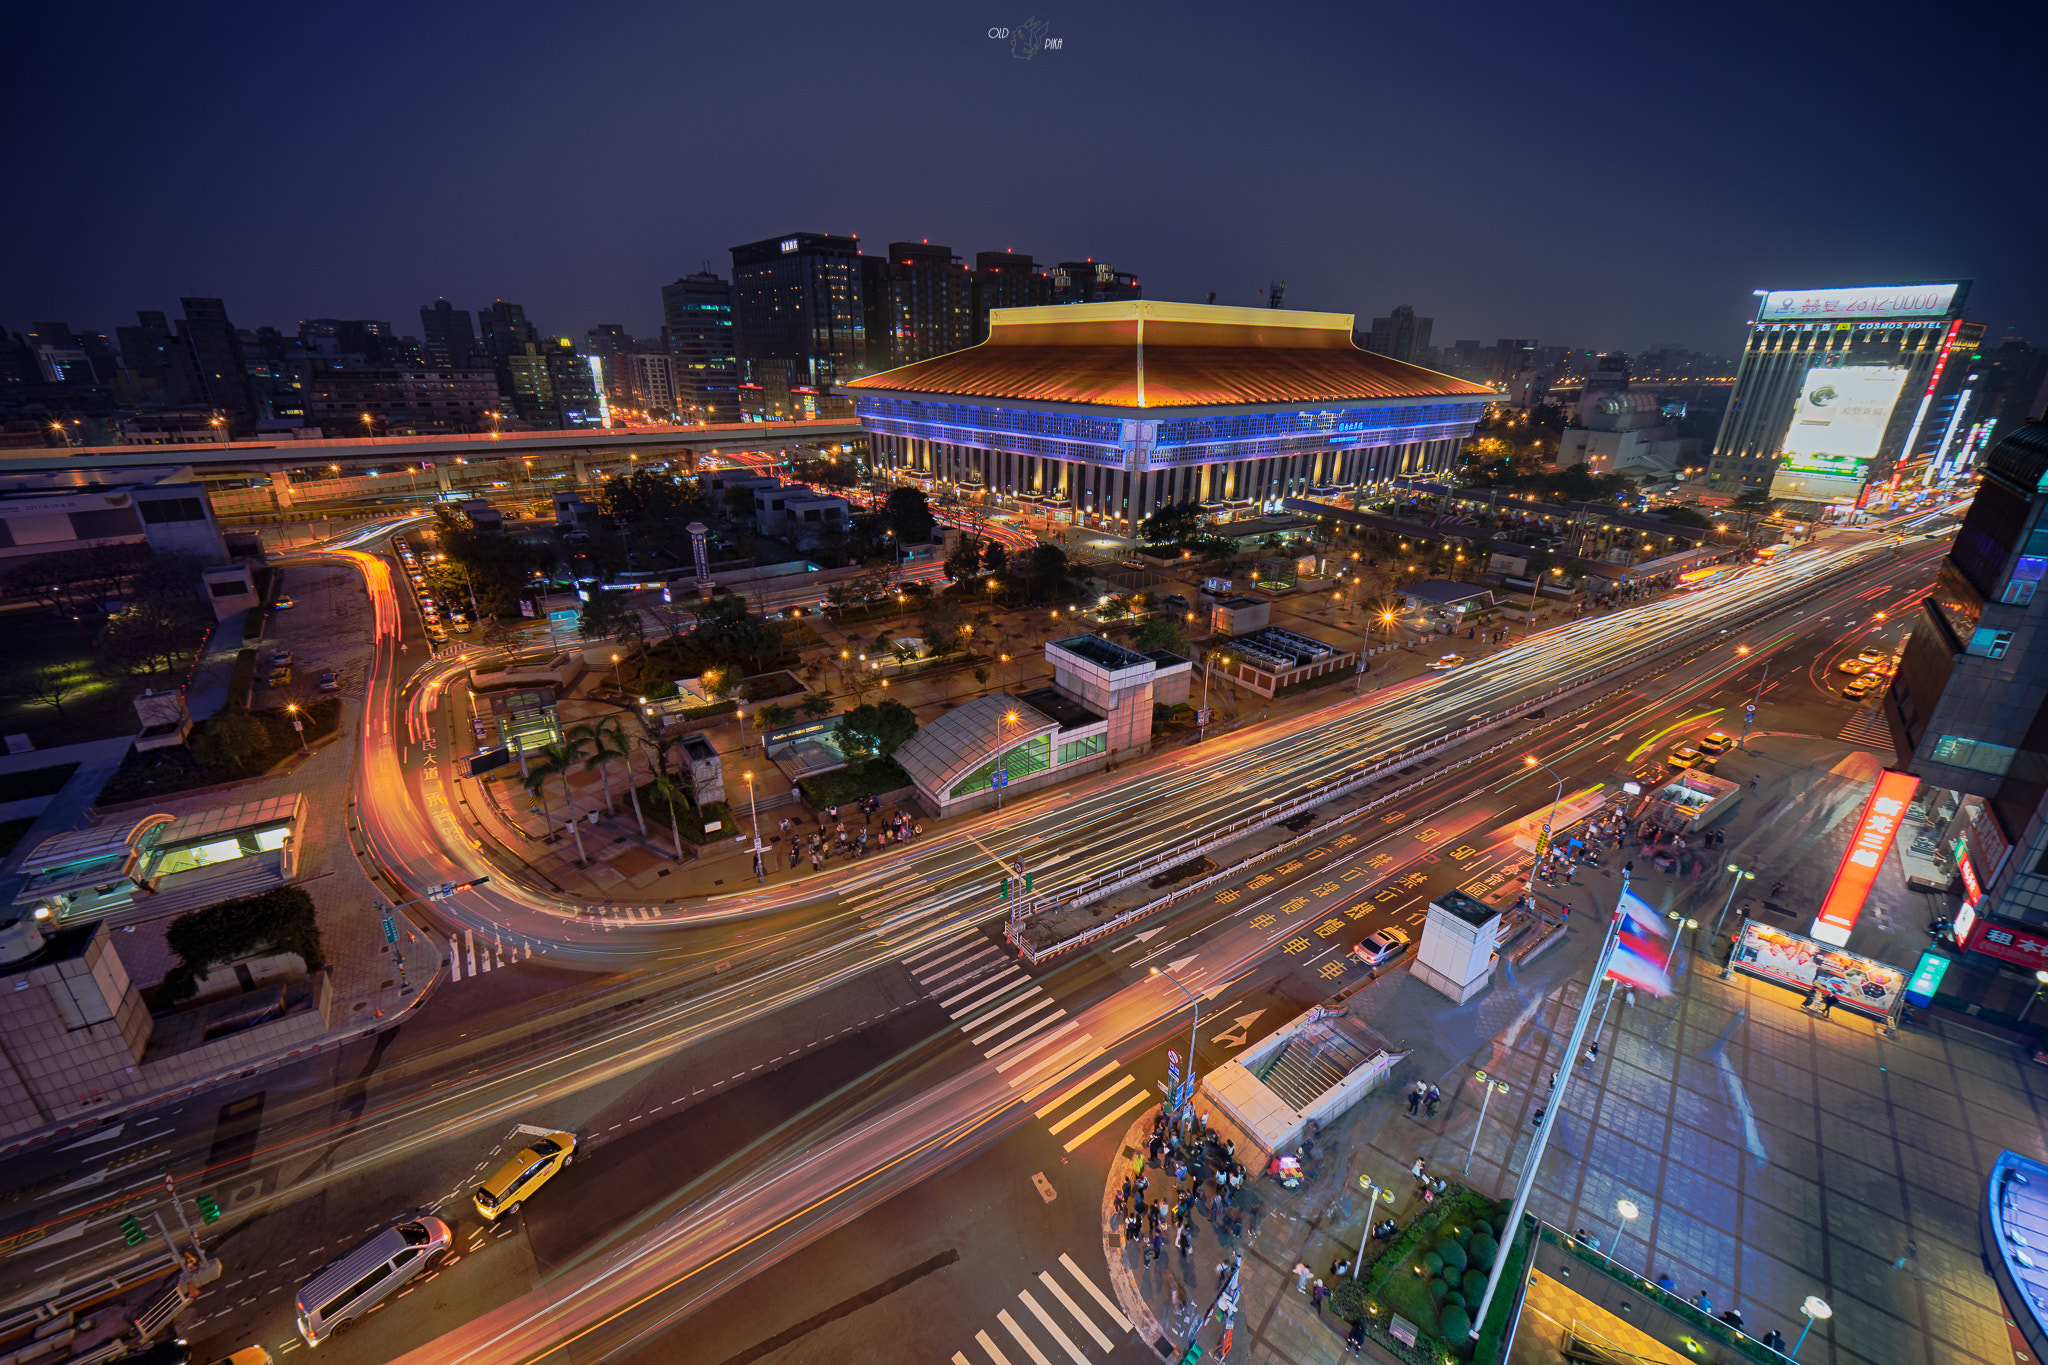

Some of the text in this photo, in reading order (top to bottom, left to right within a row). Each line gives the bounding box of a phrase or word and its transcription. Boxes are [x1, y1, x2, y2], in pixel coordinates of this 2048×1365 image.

[1846, 292, 1939, 312] 2312-0000
[1858, 321, 1942, 330] COSMOS HOTEL
[1379, 810, 1407, 825] 50
[1414, 827, 1442, 844] 50
[1449, 845, 1477, 861] 50
